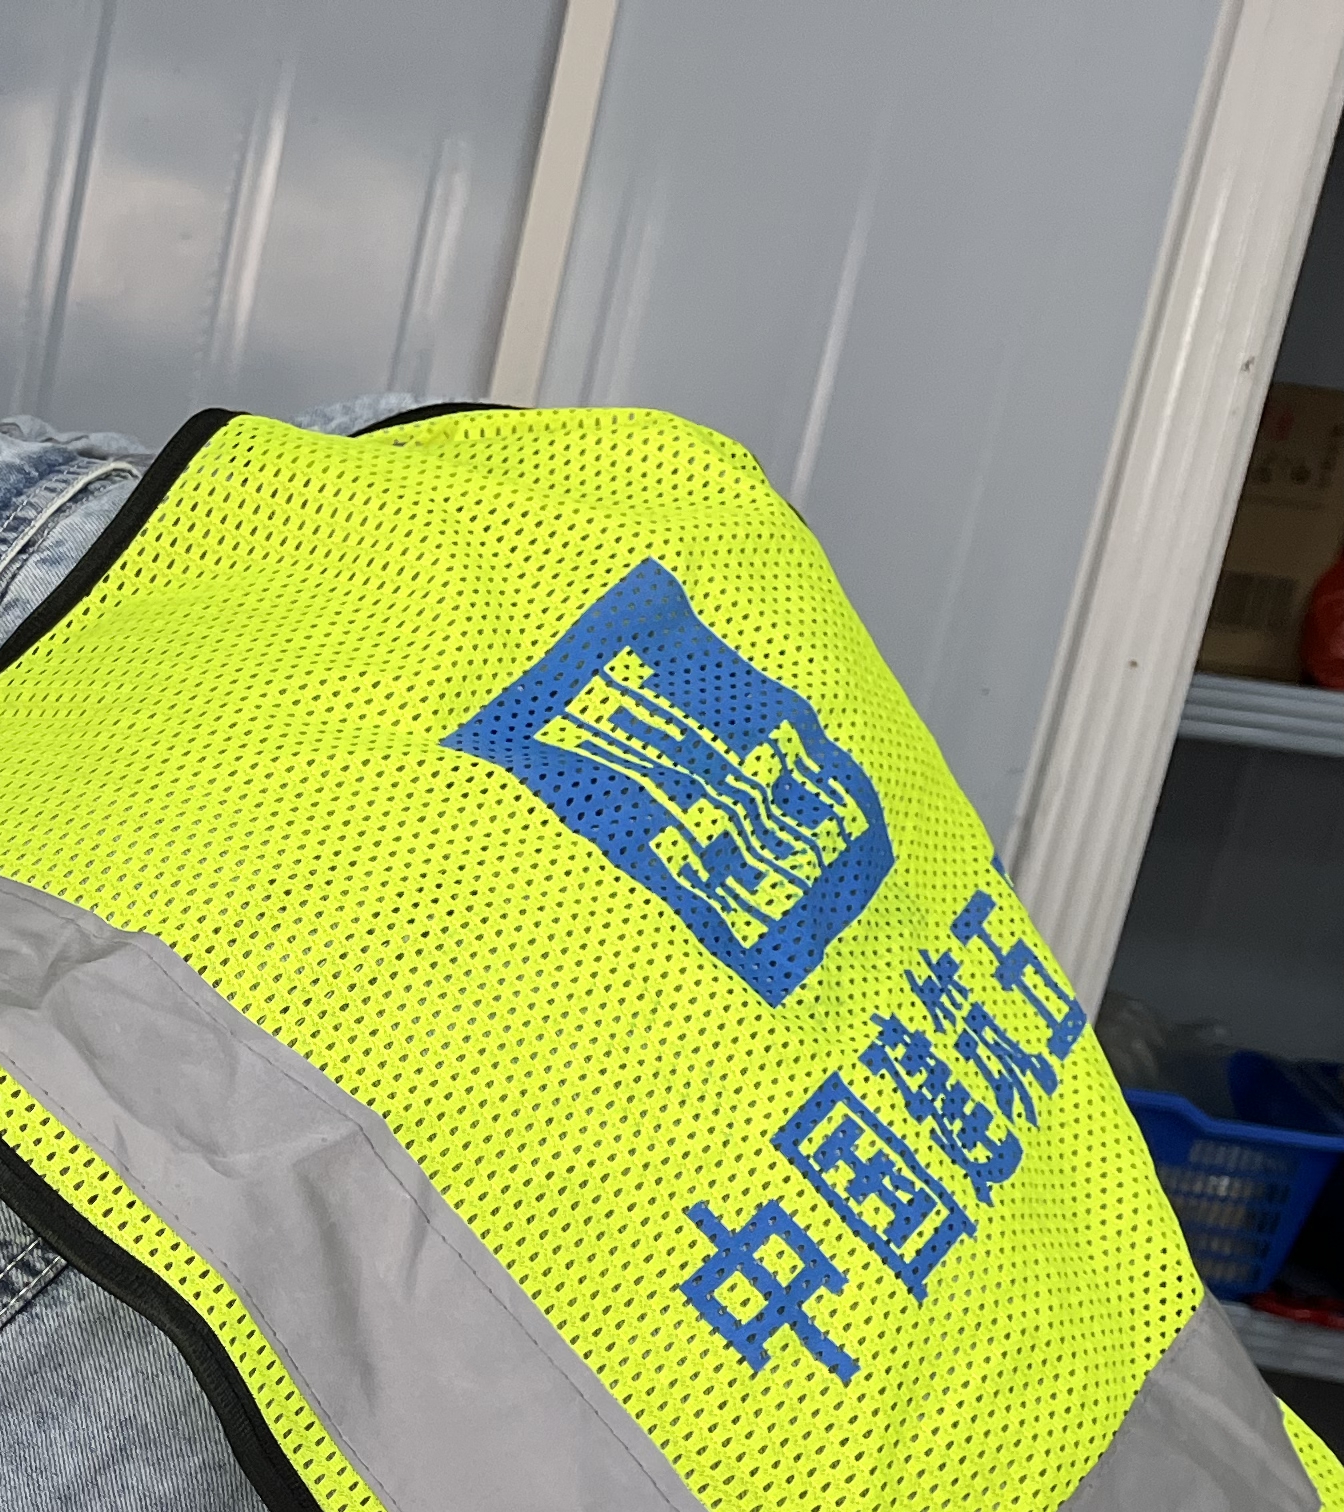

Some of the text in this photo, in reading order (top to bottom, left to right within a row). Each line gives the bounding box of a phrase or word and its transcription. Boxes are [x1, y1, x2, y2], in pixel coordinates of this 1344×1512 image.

[679, 851, 1087, 1383] 中国建筑五
